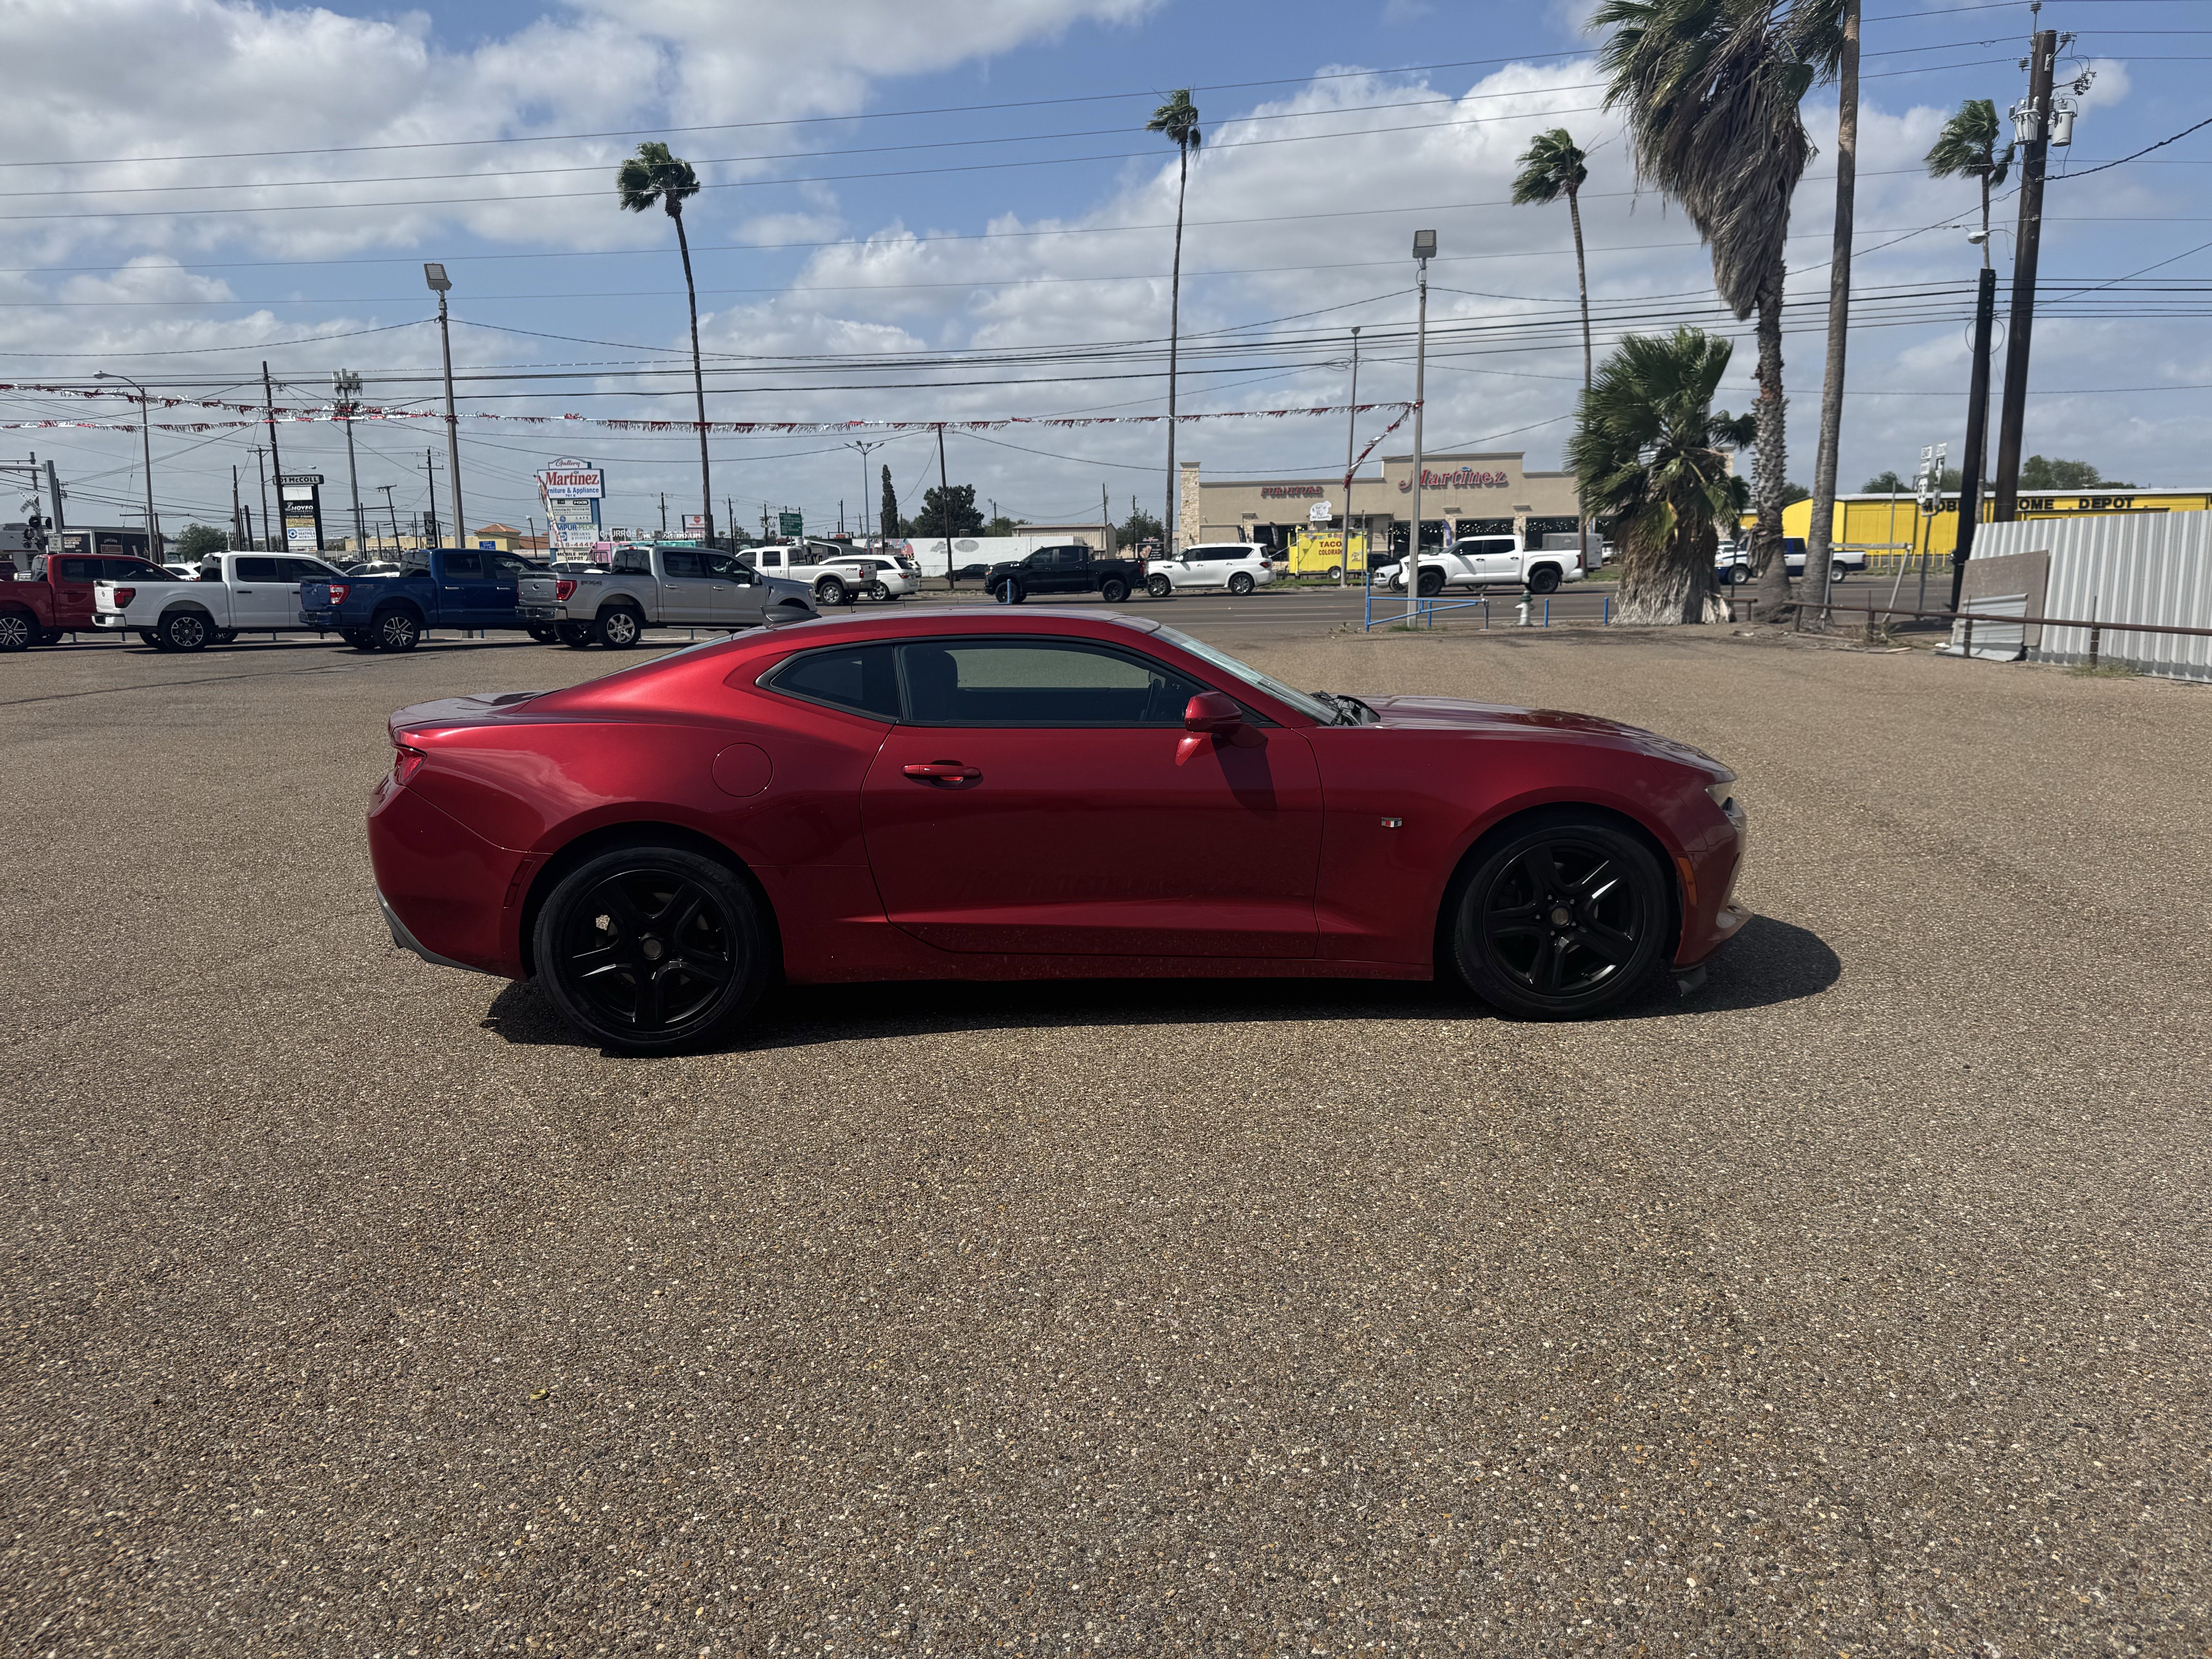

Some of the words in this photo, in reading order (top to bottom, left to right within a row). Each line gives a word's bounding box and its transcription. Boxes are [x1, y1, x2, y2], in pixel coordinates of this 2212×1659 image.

[555, 460, 580, 468] Gallery
[545, 471, 599, 486] Martinez
[1398, 469, 1507, 489] Martinez
[573, 487, 599, 495] Appliance
[1261, 486, 1322, 496] FURNITURE
[1925, 500, 1960, 512] MOB
[2016, 498, 2054, 510] OME
[2078, 497, 2135, 509] DEPOT
